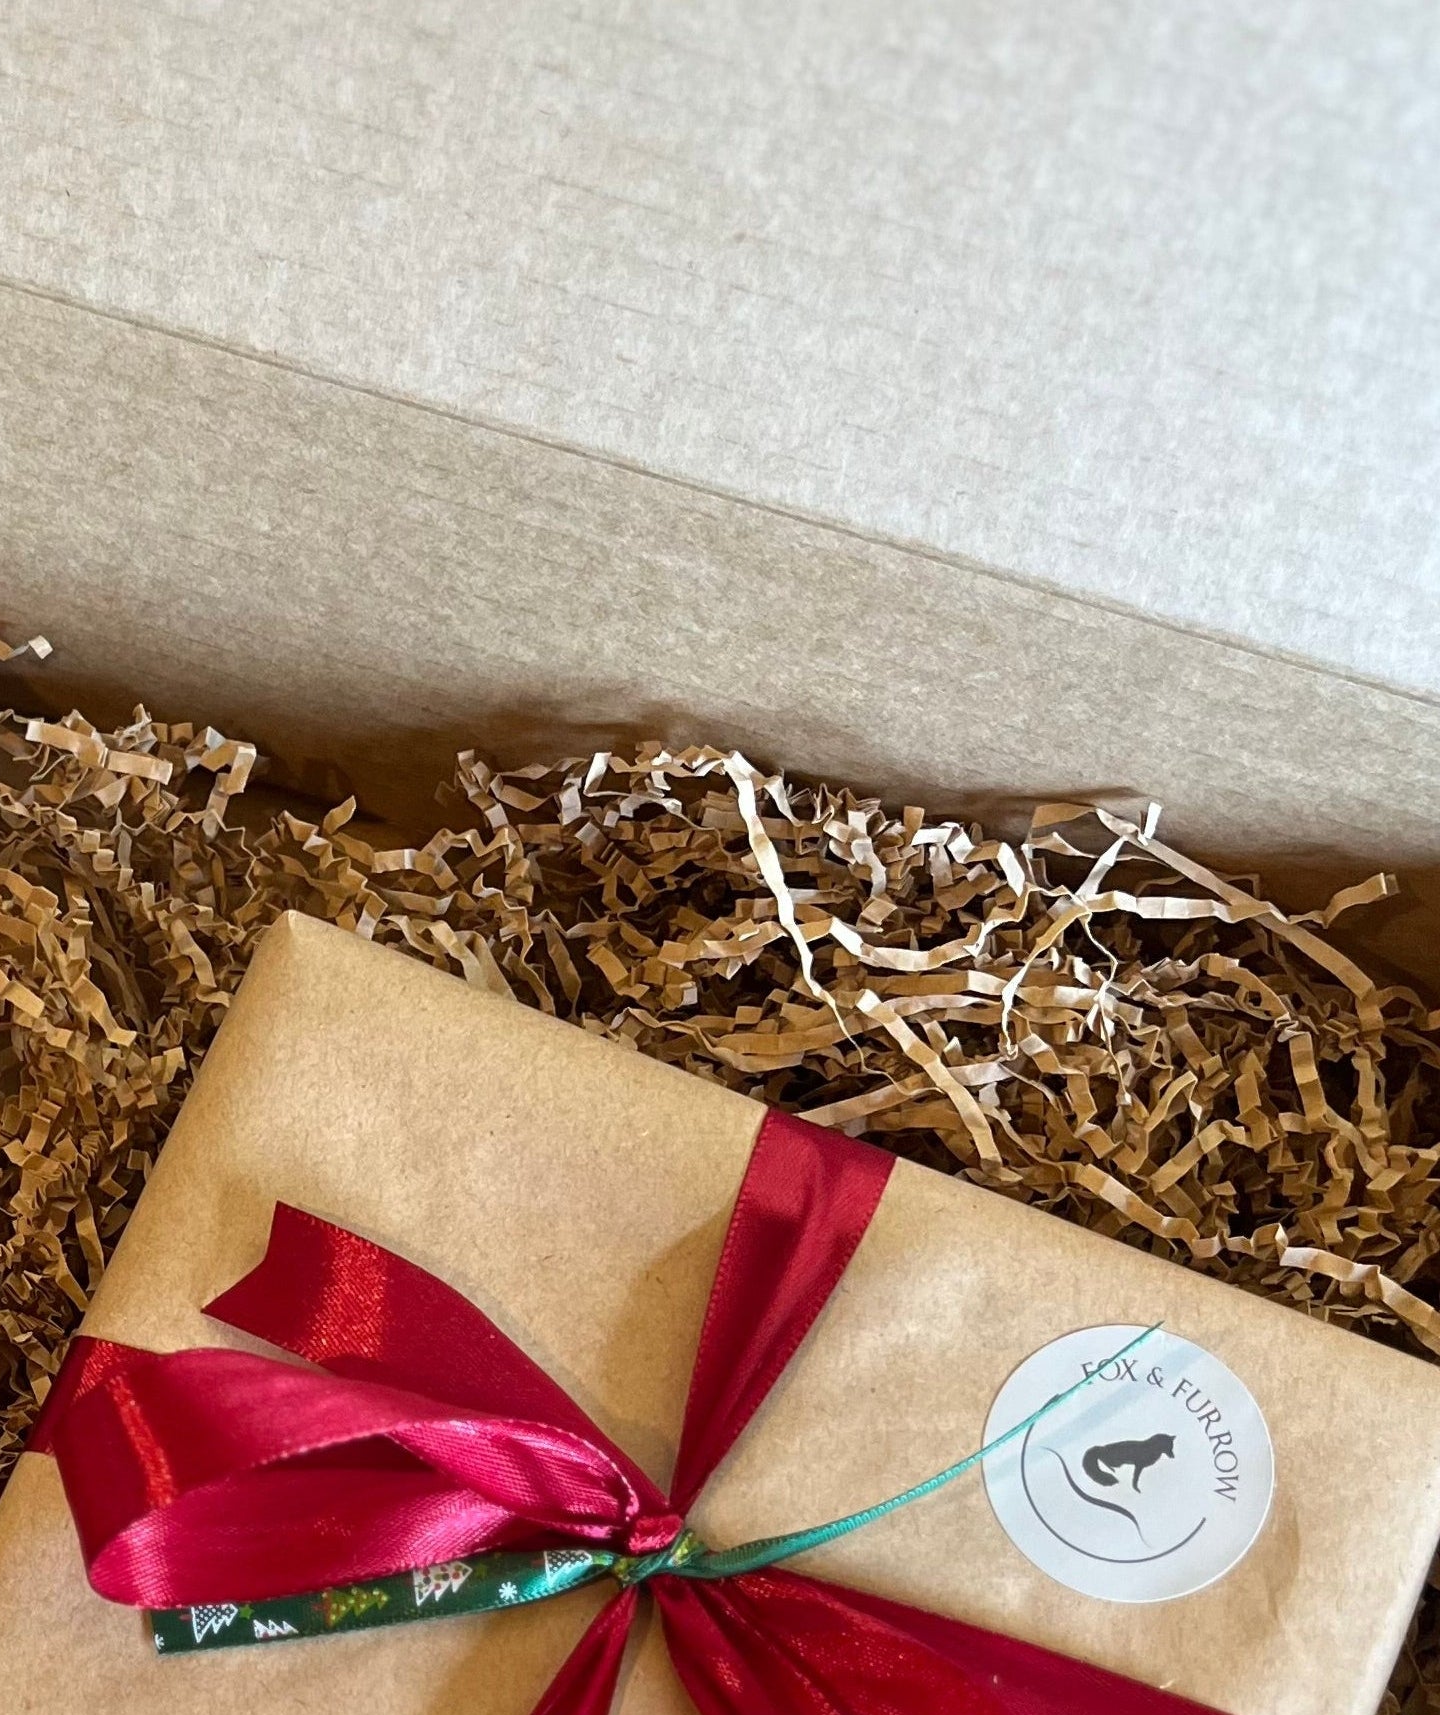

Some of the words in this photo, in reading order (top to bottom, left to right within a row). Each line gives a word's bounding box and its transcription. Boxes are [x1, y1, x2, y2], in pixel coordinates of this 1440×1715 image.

[1080, 1358, 1138, 1383] FOX
[1146, 1366, 1165, 1389] &
[1171, 1378, 1240, 1503] FURROW
